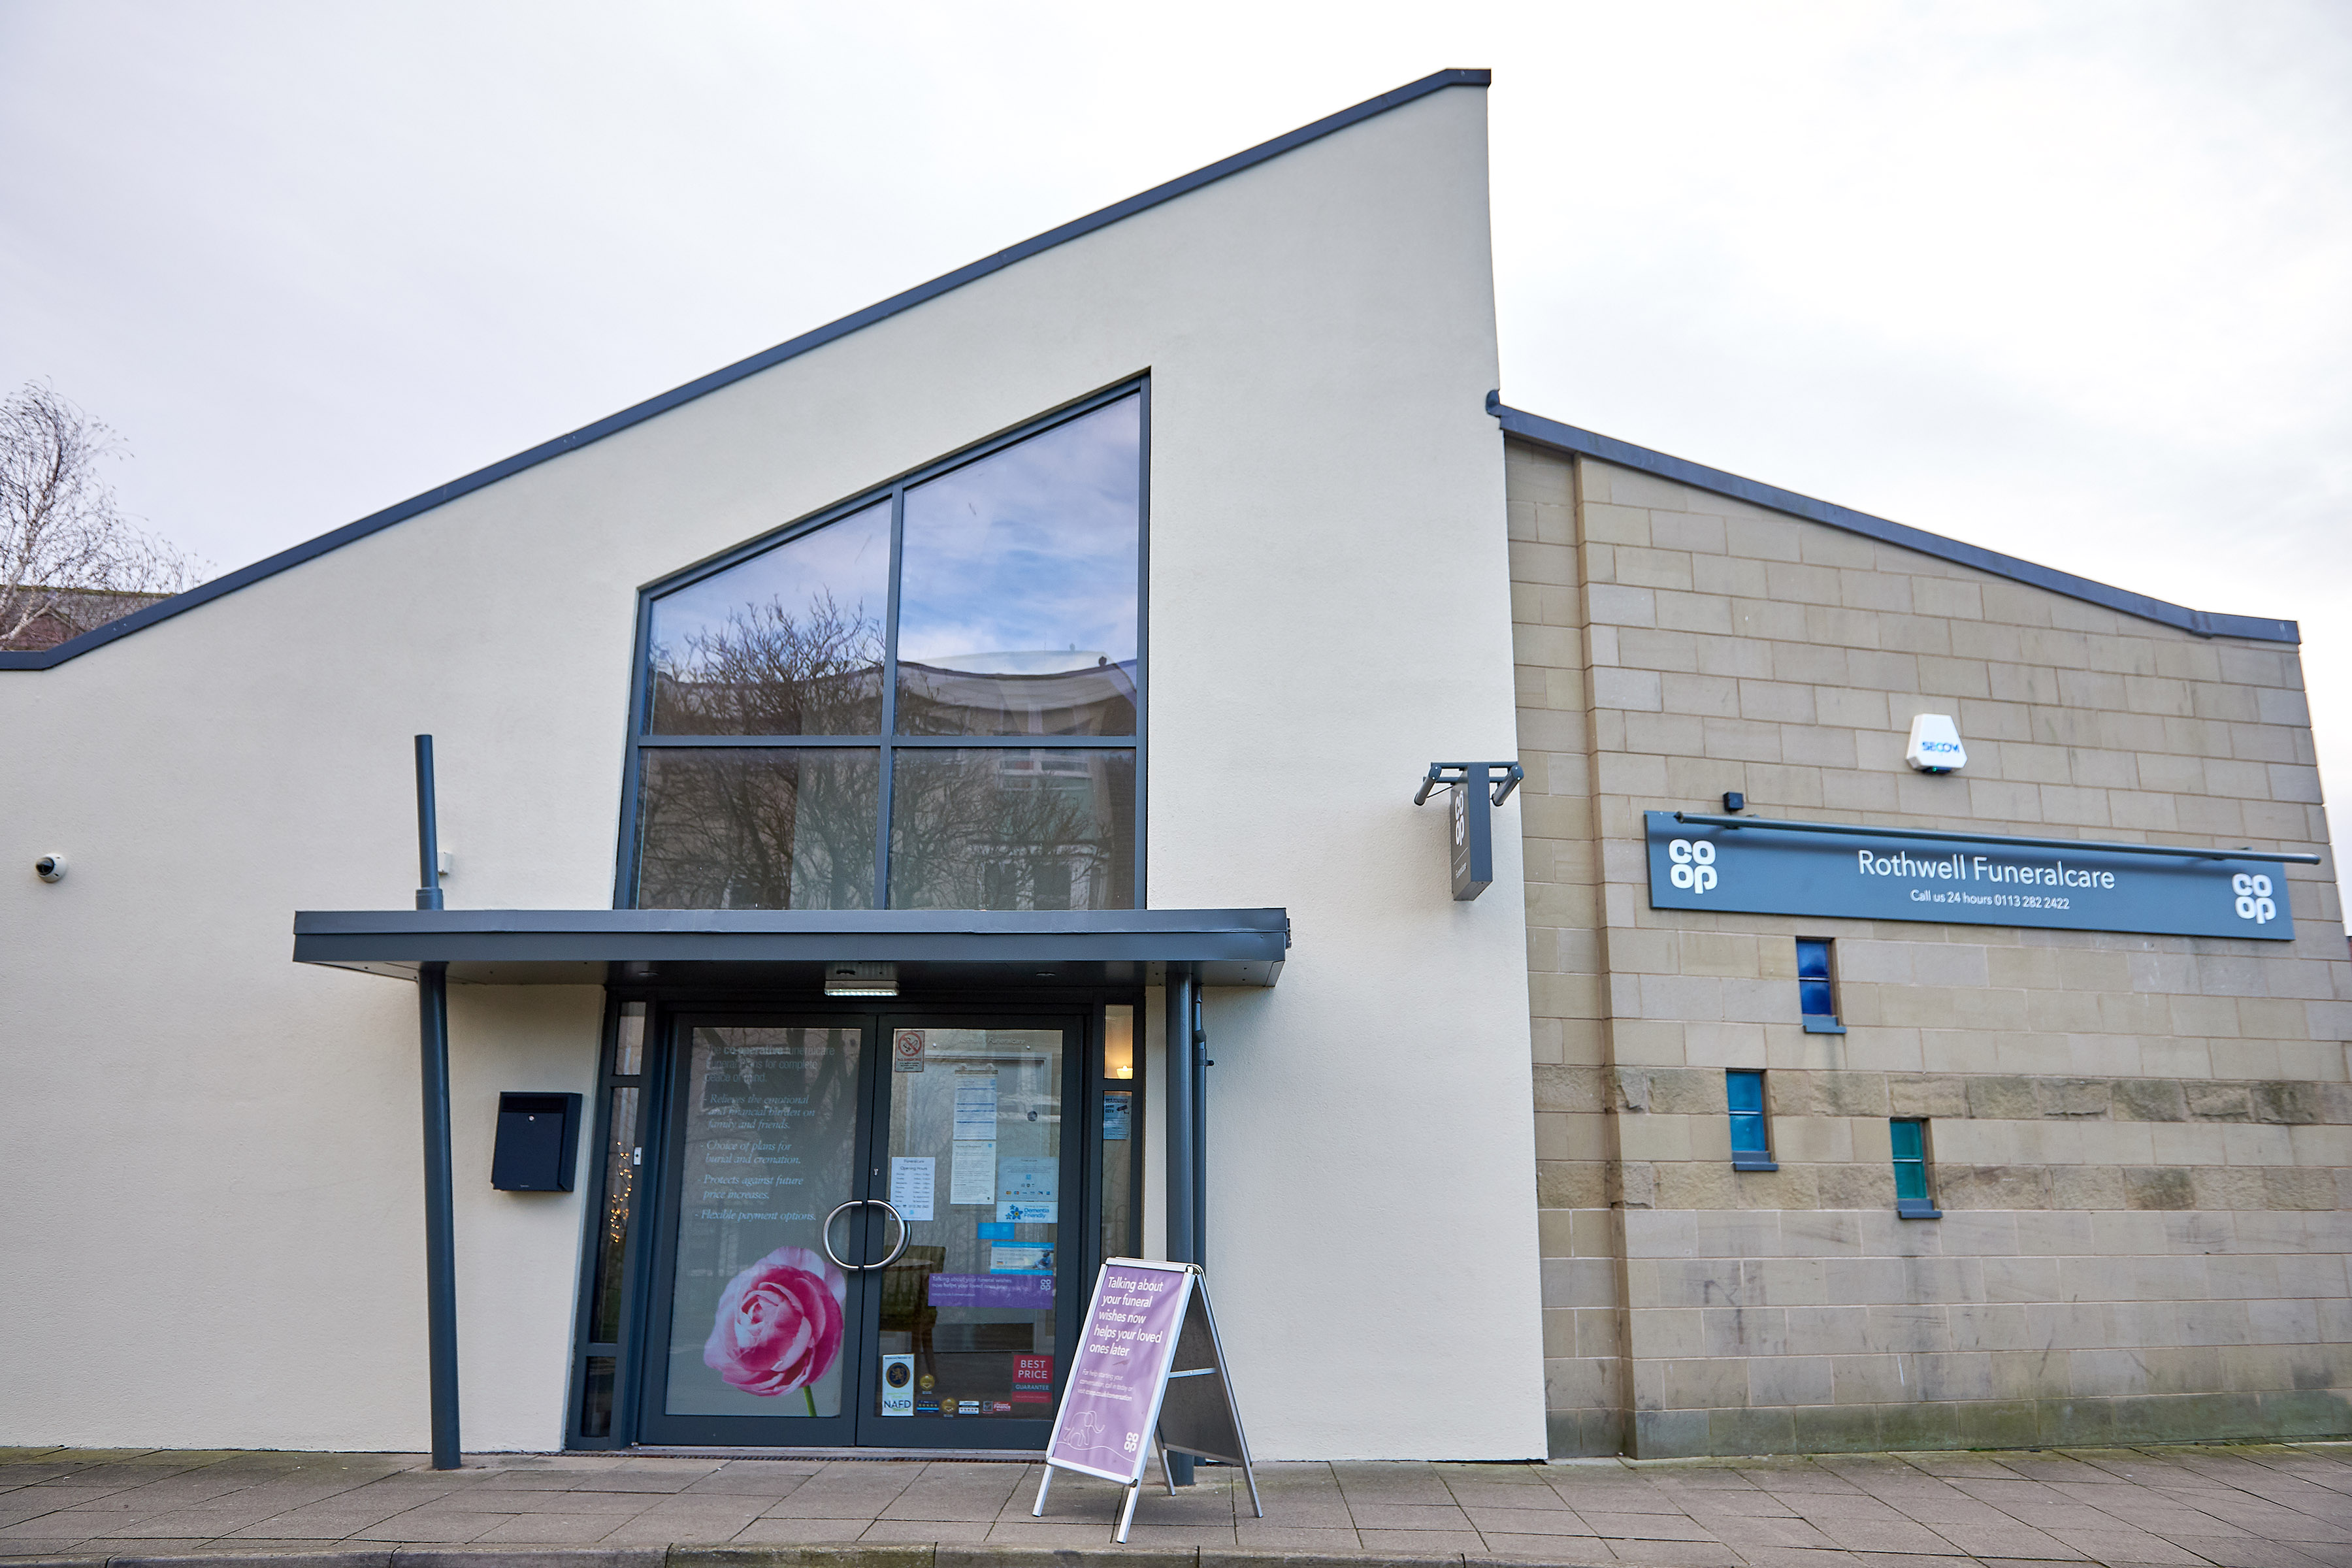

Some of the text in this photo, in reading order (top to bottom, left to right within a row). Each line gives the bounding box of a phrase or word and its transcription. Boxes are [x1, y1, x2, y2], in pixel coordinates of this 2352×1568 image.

[1922, 741, 1960, 753] SECOM
[1858, 849, 2116, 889] Rothwell Funeralcare
[1910, 889, 2070, 910] Call us 24 hours 0113 282 2422
[765, 1059, 777, 1070] for
[779, 1059, 818, 1071] complete
[710, 1094, 810, 1104] Relieves the emotional
[768, 1107, 801, 1117] burden
[708, 1119, 791, 1131] family and friends.
[706, 1141, 792, 1153] Choice of plans for
[706, 1153, 801, 1164] burial and cremation.
[704, 1174, 804, 1187] Protects against future
[703, 1189, 770, 1200] price increases.
[701, 1209, 817, 1223] Flexible payment options.
[1108, 1276, 1164, 1293] Talking about
[1101, 1294, 1154, 1308] your funeral
[1099, 1309, 1147, 1324] wishes now
[1093, 1324, 1163, 1343] helps your loved
[1089, 1342, 1130, 1357] ones later
[1020, 1360, 1046, 1369] BEST
[1018, 1370, 1048, 1379] PRICE
[1088, 1369, 1098, 1378] help
[1098, 1373, 1114, 1381] starting
[1117, 1384, 1128, 1393] today
[883, 1399, 911, 1409] NAFD
